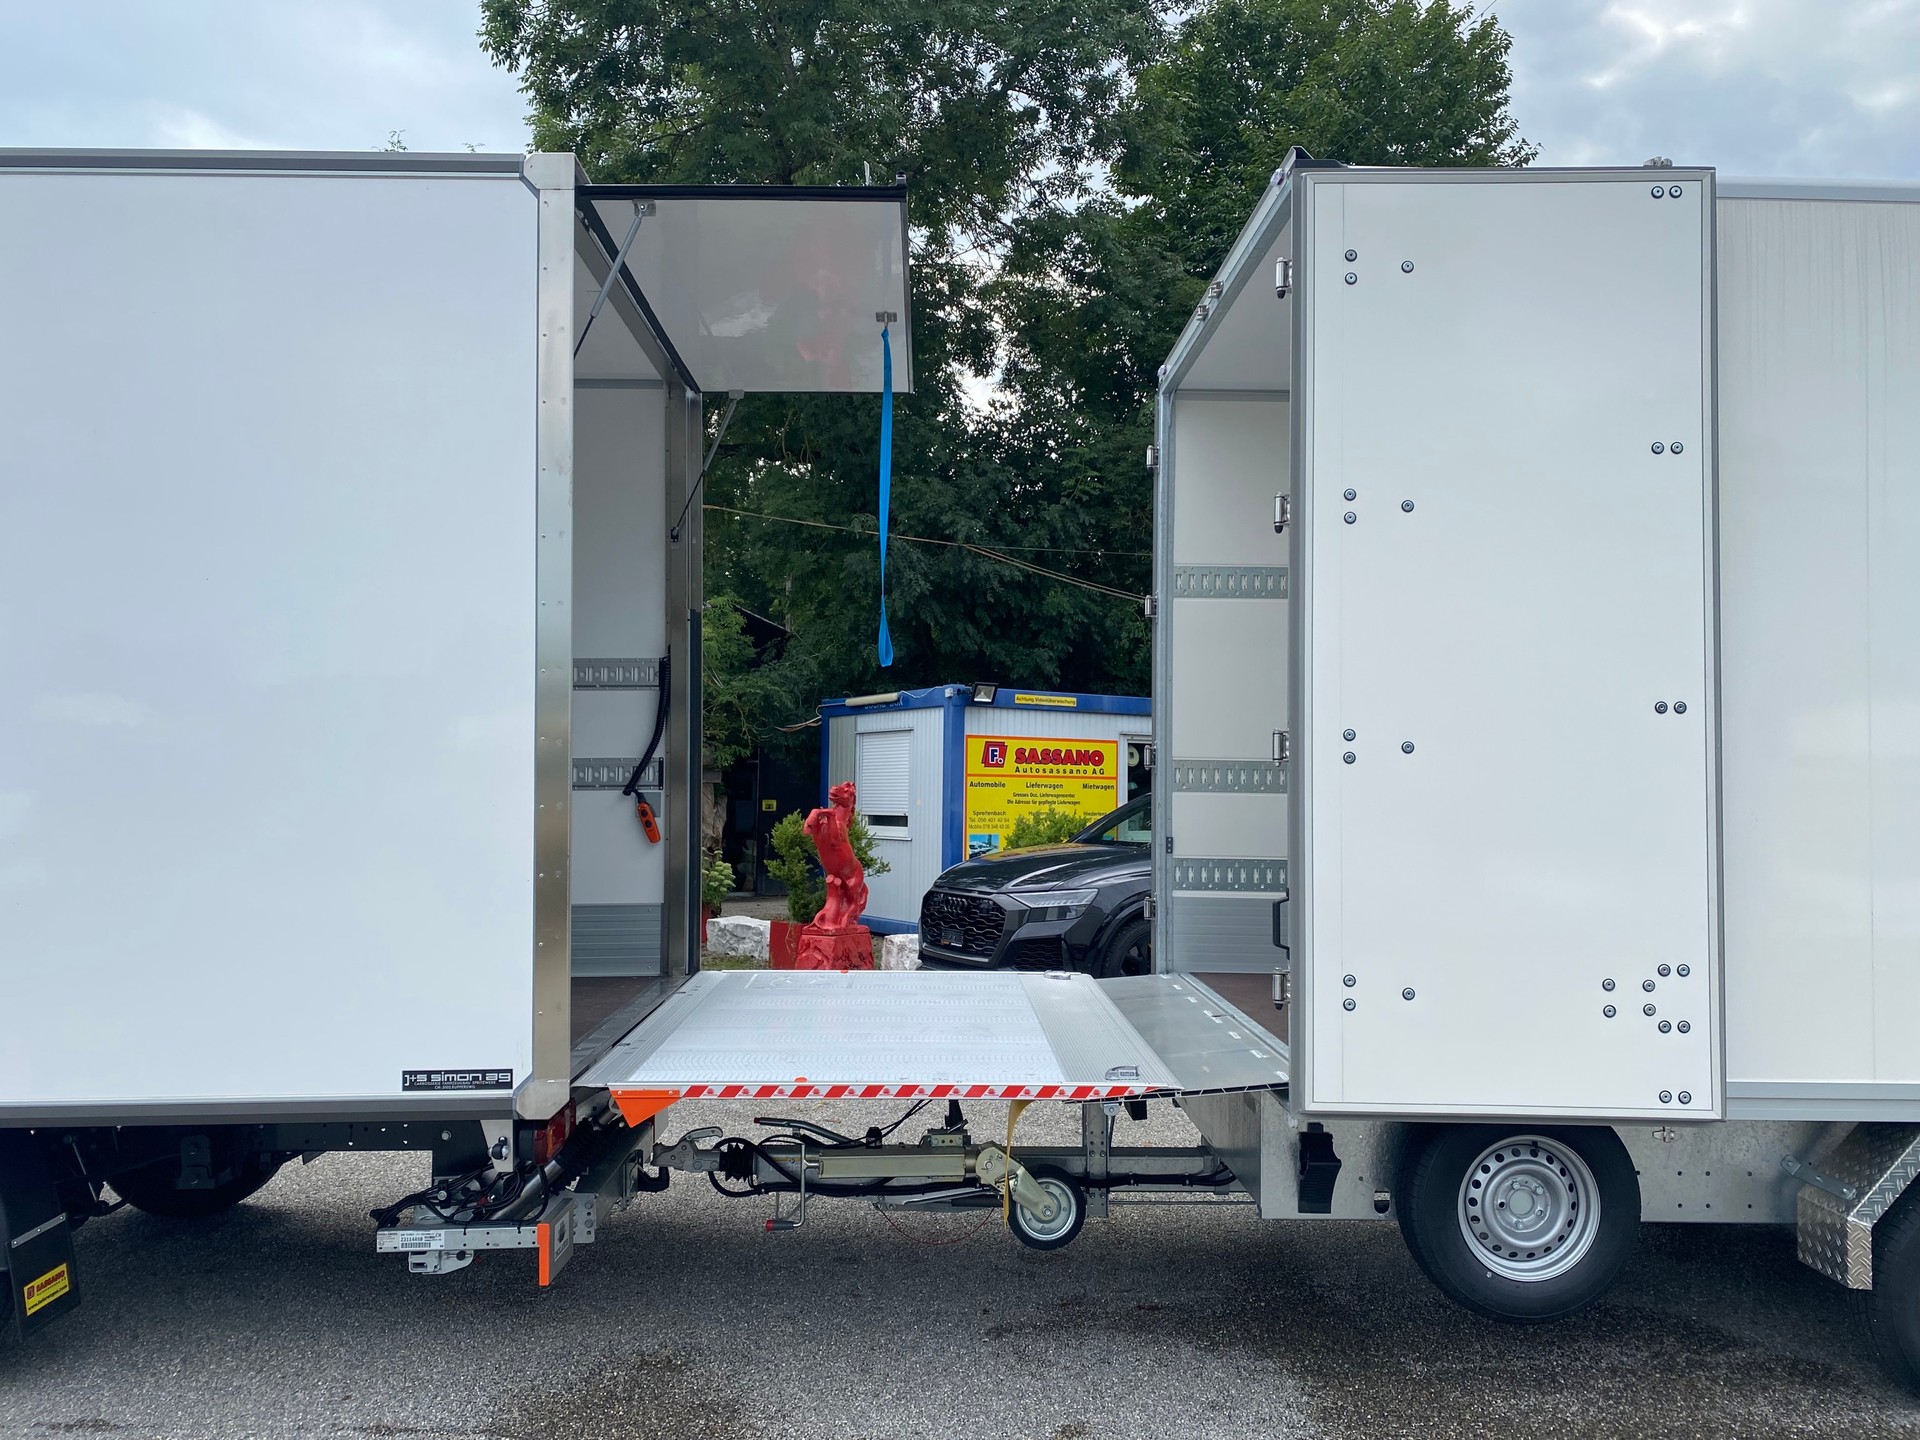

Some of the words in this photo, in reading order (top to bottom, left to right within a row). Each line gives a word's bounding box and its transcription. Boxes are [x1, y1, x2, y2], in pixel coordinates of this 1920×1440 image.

[1015, 748, 1104, 766] SASSANO
[1015, 766, 1087, 774] Autosassano
[1092, 767, 1105, 775] AG
[1025, 782, 1064, 790] Lieferwagen
[1082, 783, 1115, 791] Mietwagen
[431, 1072, 482, 1082] simon
[486, 1073, 511, 1082] ag
